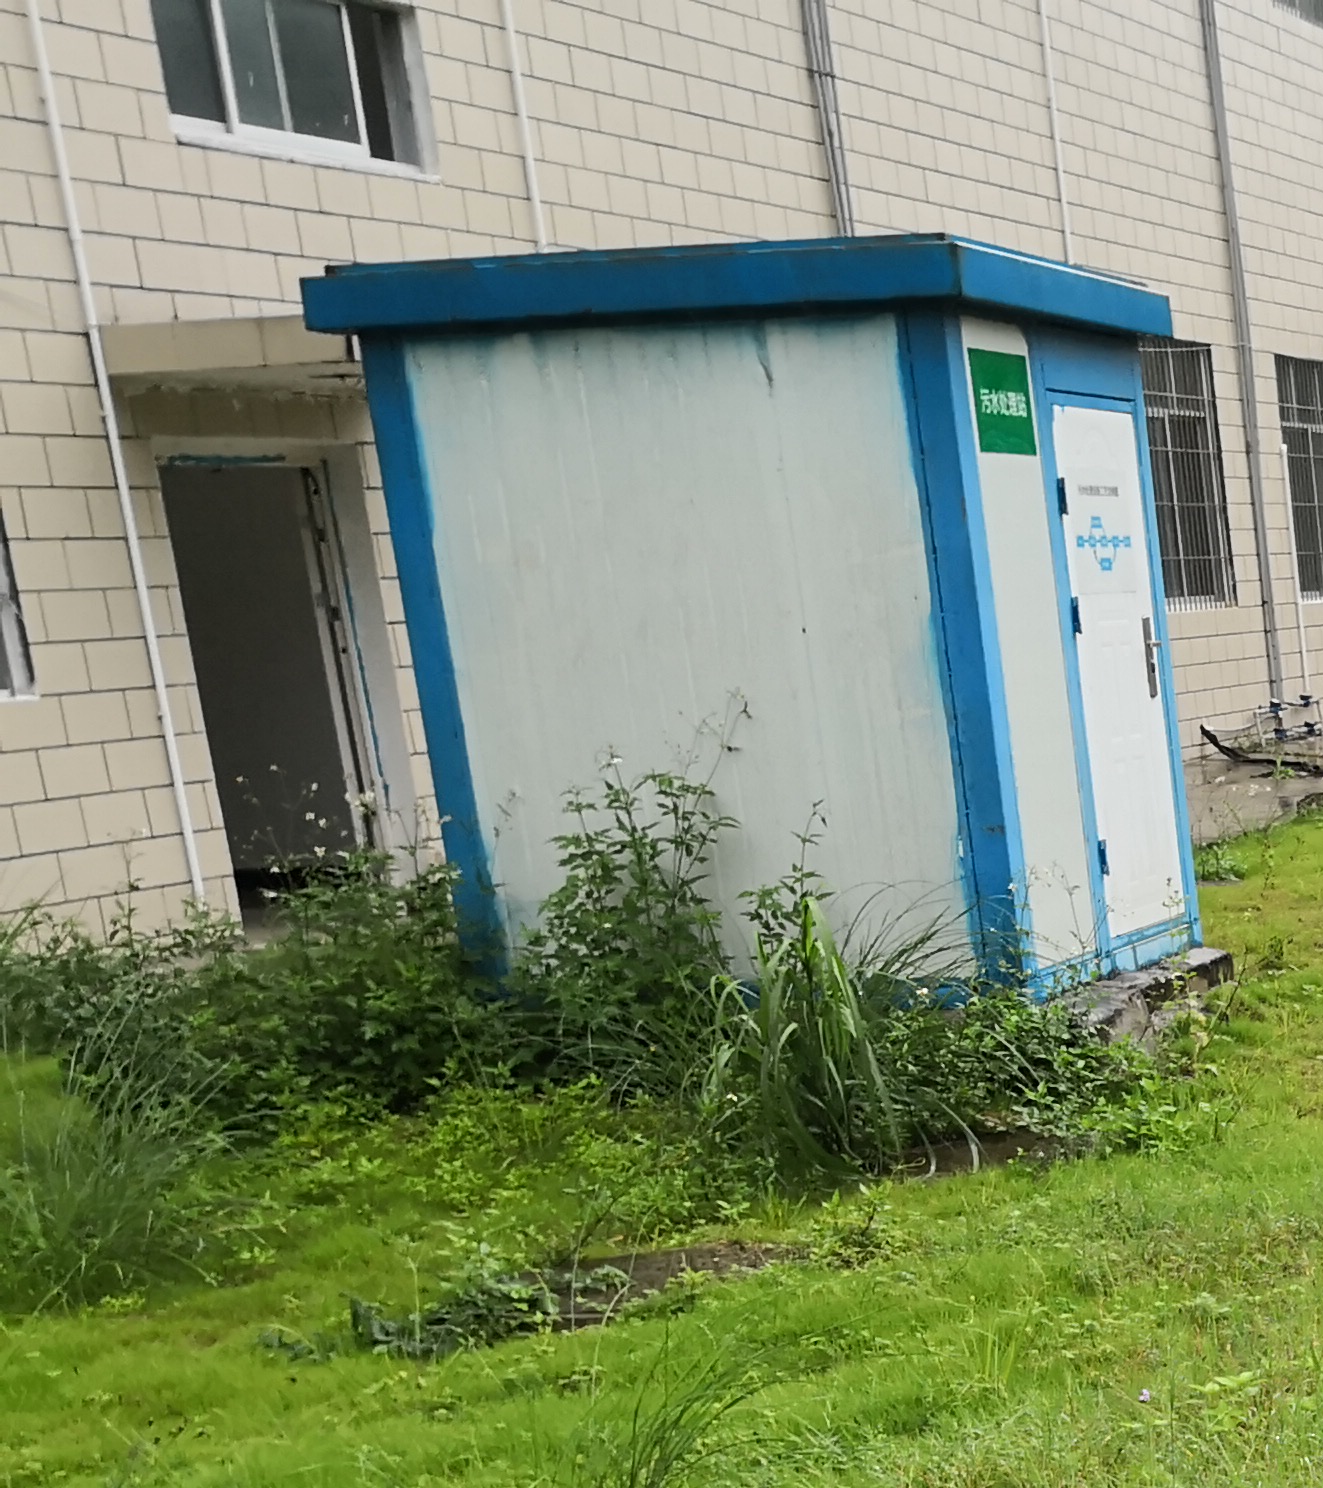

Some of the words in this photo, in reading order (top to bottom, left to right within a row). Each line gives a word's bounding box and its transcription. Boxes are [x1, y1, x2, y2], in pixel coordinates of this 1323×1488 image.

[979, 386, 1028, 418] 污水处理站
